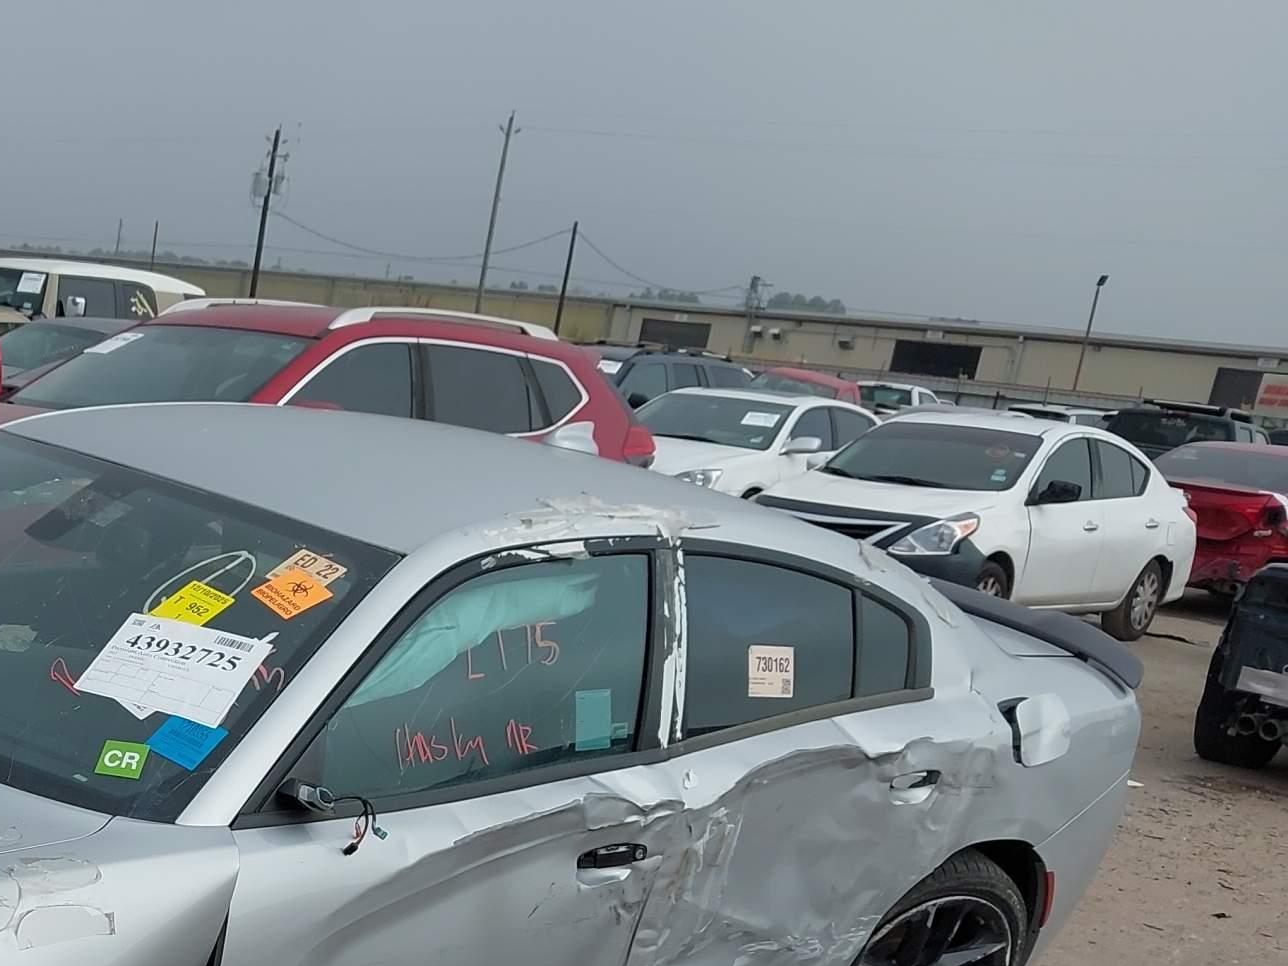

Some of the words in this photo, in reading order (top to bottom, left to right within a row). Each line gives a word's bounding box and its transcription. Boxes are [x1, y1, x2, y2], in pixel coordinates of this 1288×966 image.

[294, 553, 314, 569] ED
[316, 563, 340, 580] 22
[173, 595, 185, 605] T
[185, 602, 210, 618] 952
[255, 588, 293, 616] BIOPELIGRO
[264, 583, 302, 611] BIOHAZARD
[125, 633, 243, 672] 43932725
[755, 656, 790, 673] 730162
[103, 749, 141, 770] CR
